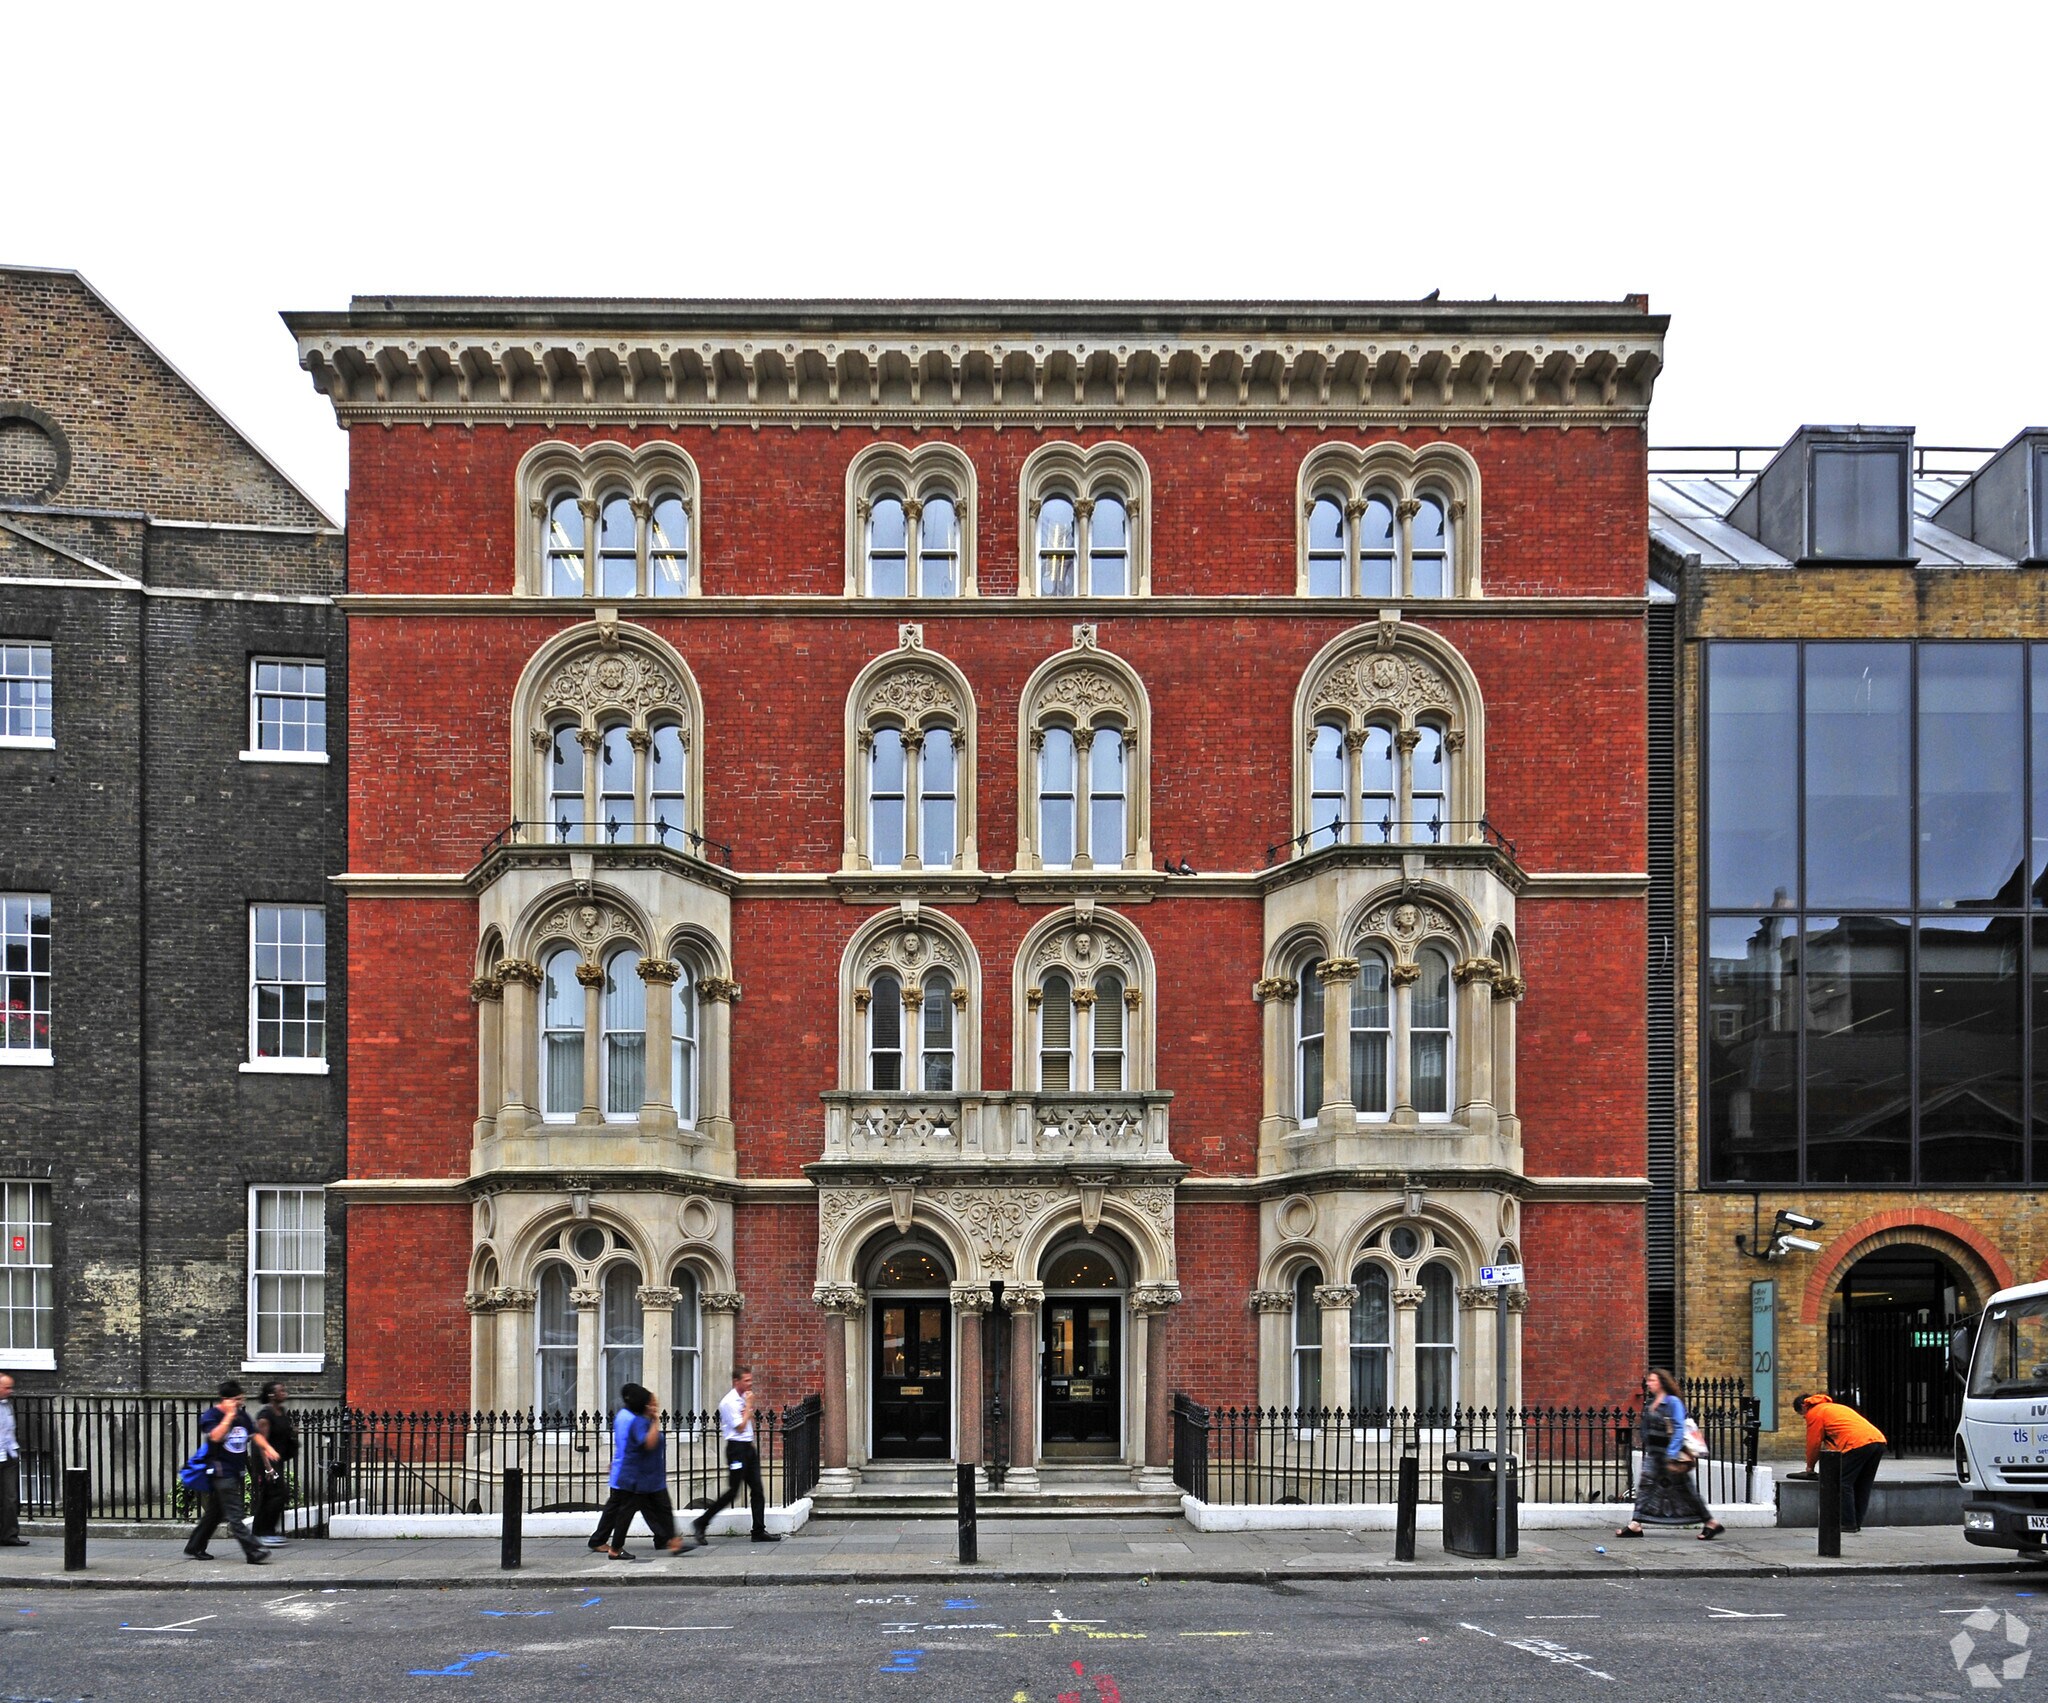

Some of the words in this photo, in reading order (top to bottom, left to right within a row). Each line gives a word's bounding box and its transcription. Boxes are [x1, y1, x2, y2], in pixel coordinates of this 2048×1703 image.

[1483, 1269, 1492, 1279] P
[1753, 1305, 1773, 1313] COURT
[1754, 1351, 1772, 1373] 20
[1056, 1388, 1066, 1396] 24
[1095, 1388, 1106, 1396] 26
[2031, 1405, 2048, 1417] IV
[2013, 1428, 2028, 1443] tls
[1994, 1456, 2045, 1464] EURO
